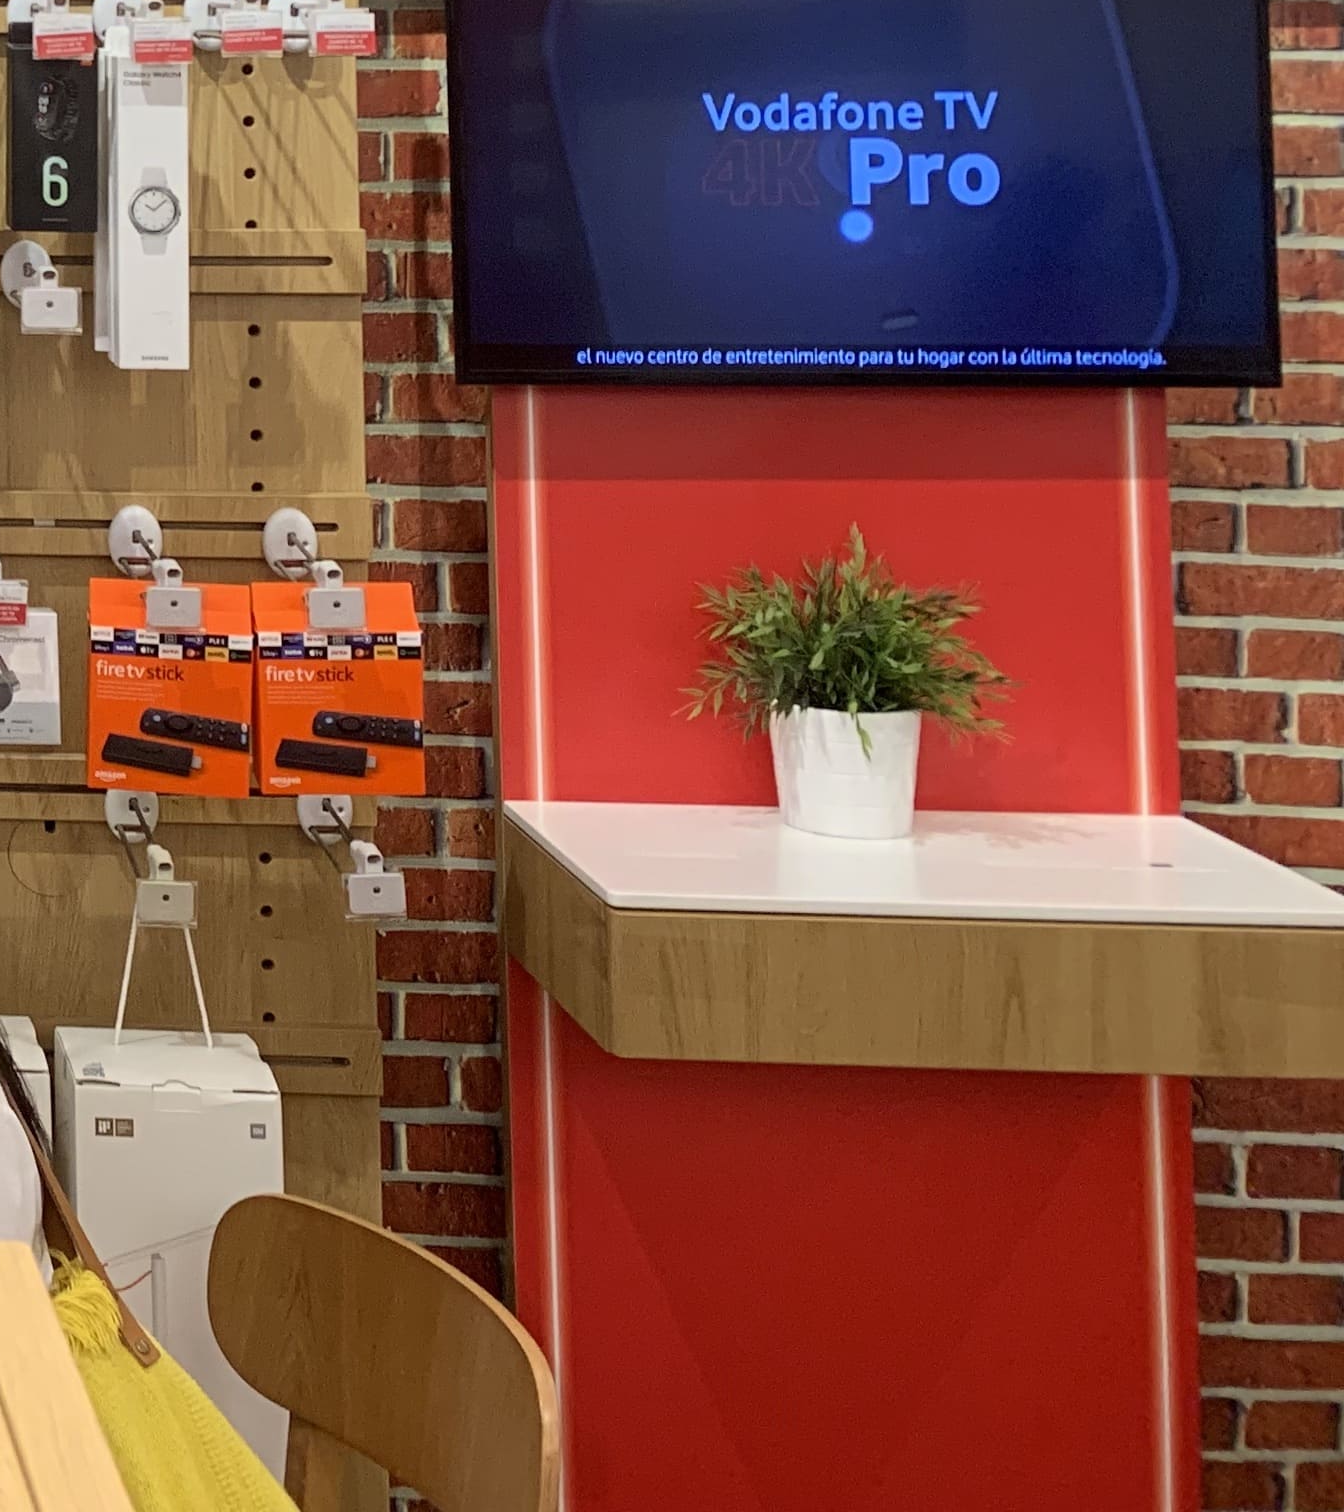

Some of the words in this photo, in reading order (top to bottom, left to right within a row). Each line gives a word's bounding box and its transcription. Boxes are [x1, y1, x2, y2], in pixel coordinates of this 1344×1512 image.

[703, 92, 923, 131] Vodafone
[934, 92, 997, 129] TV
[43, 156, 67, 206] 6
[850, 138, 1000, 205] Pro
[577, 348, 592, 367] el
[596, 351, 644, 364] nuevo
[648, 349, 698, 364] centro
[703, 348, 722, 367] de
[726, 348, 855, 364] entretenimiento
[858, 351, 894, 369] para
[897, 350, 913, 367] tu
[918, 348, 965, 368] hogar
[968, 351, 998, 367] con
[1002, 348, 1017, 367] la
[1020, 348, 1072, 365] última
[1076, 348, 1166, 369] tecnología.
[147, 665, 184, 681] stick
[317, 666, 354, 681] stick
